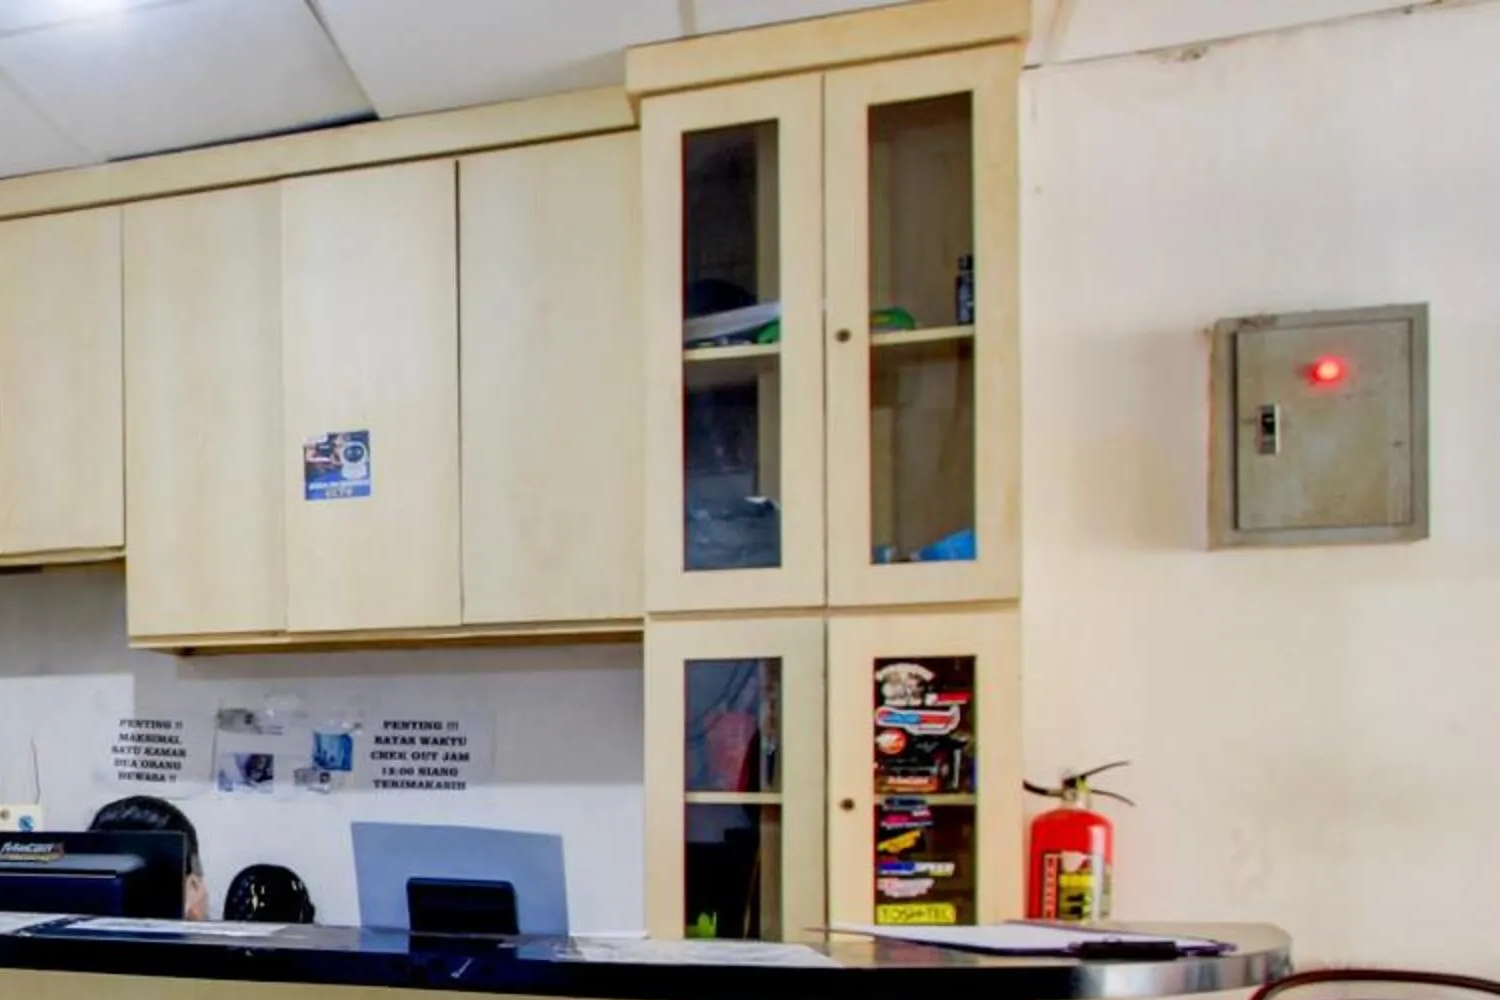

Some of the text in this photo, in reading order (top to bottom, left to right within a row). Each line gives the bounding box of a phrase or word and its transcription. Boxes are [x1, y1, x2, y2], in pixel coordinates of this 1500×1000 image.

[383, 720, 442, 730] PENTING
[420, 736, 467, 746] WAKTU
[411, 751, 438, 761] OUT
[443, 752, 470, 761] JAM
[418, 767, 459, 777] SIANG
